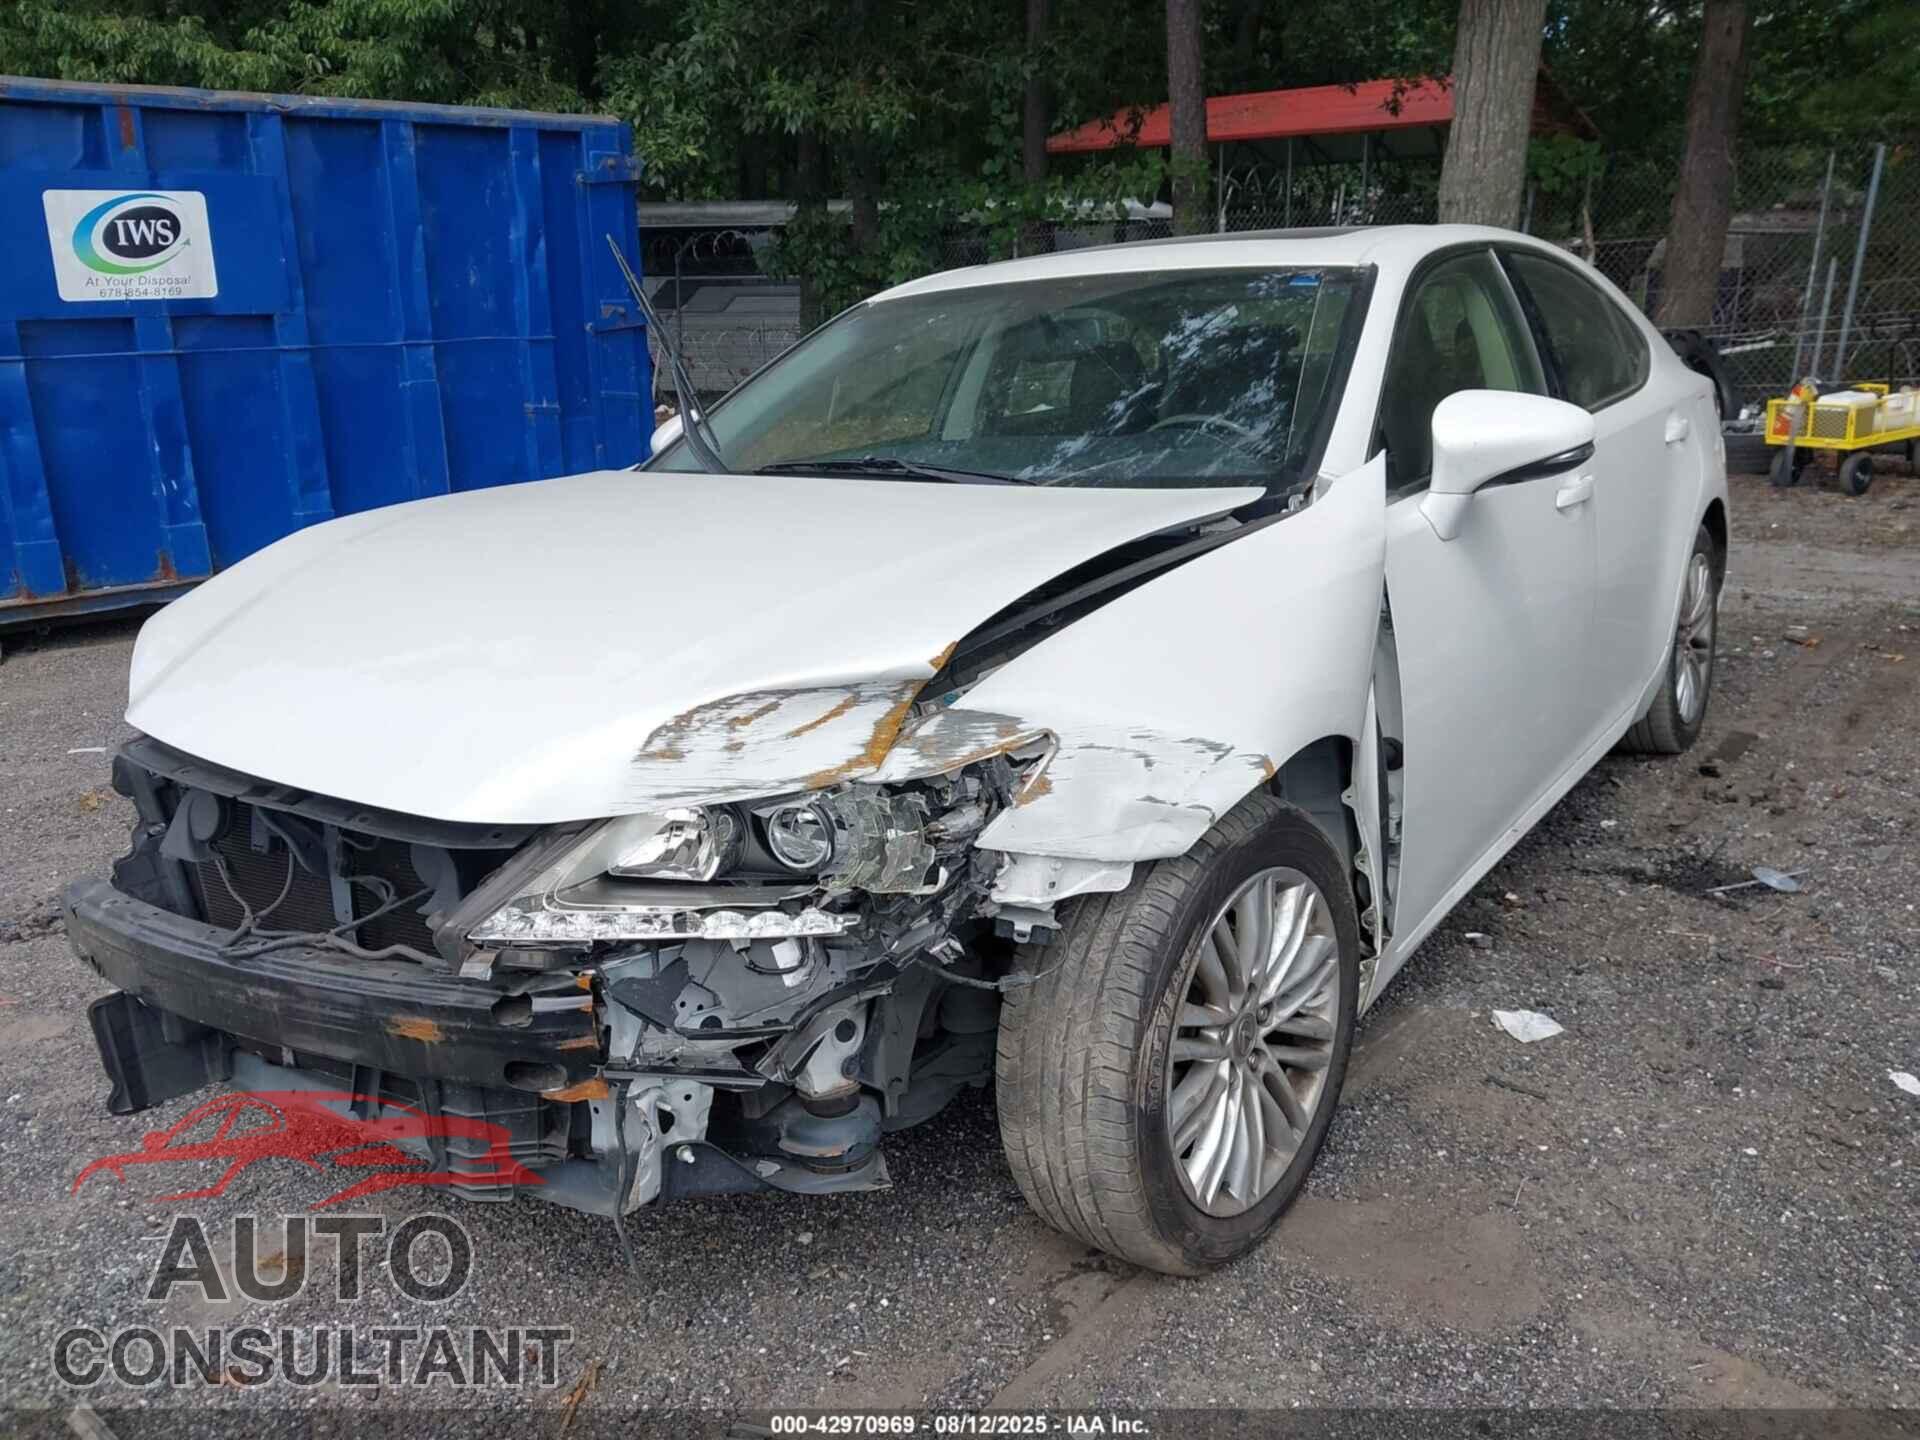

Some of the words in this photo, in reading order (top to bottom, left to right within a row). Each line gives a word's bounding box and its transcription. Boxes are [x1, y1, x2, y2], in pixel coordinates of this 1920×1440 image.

[113, 219, 174, 246] IWS
[86, 276, 99, 287] At
[104, 276, 133, 287] Your
[138, 275, 192, 287] Disposal
[100, 287, 182, 297] 678-854-8169
